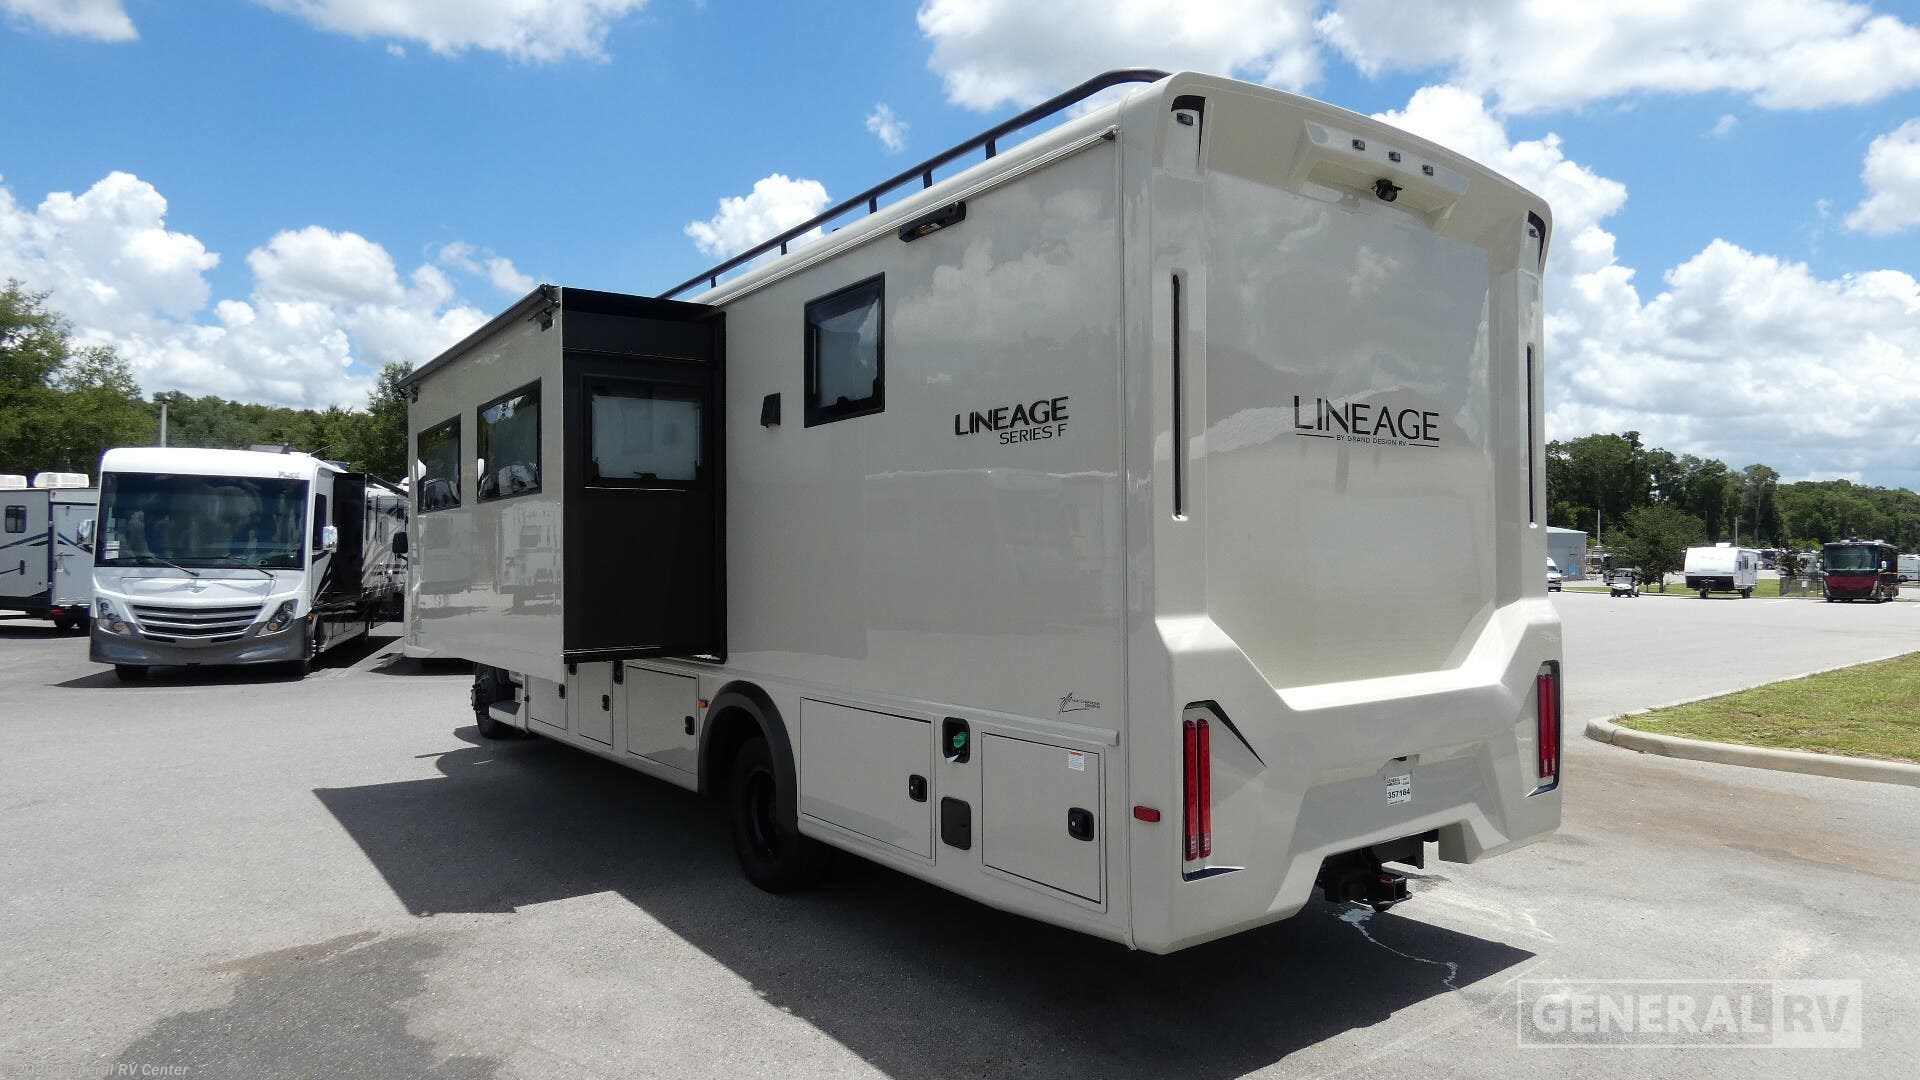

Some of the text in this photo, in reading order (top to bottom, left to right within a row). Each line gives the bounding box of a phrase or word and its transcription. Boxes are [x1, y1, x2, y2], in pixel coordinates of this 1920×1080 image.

[955, 396, 1068, 435] LINEAGE
[1294, 396, 1440, 441] LINEAGE
[1000, 423, 1067, 445] SERIES F
[1348, 435, 1371, 443] GRAND
[1373, 437, 1397, 446] DESIGN
